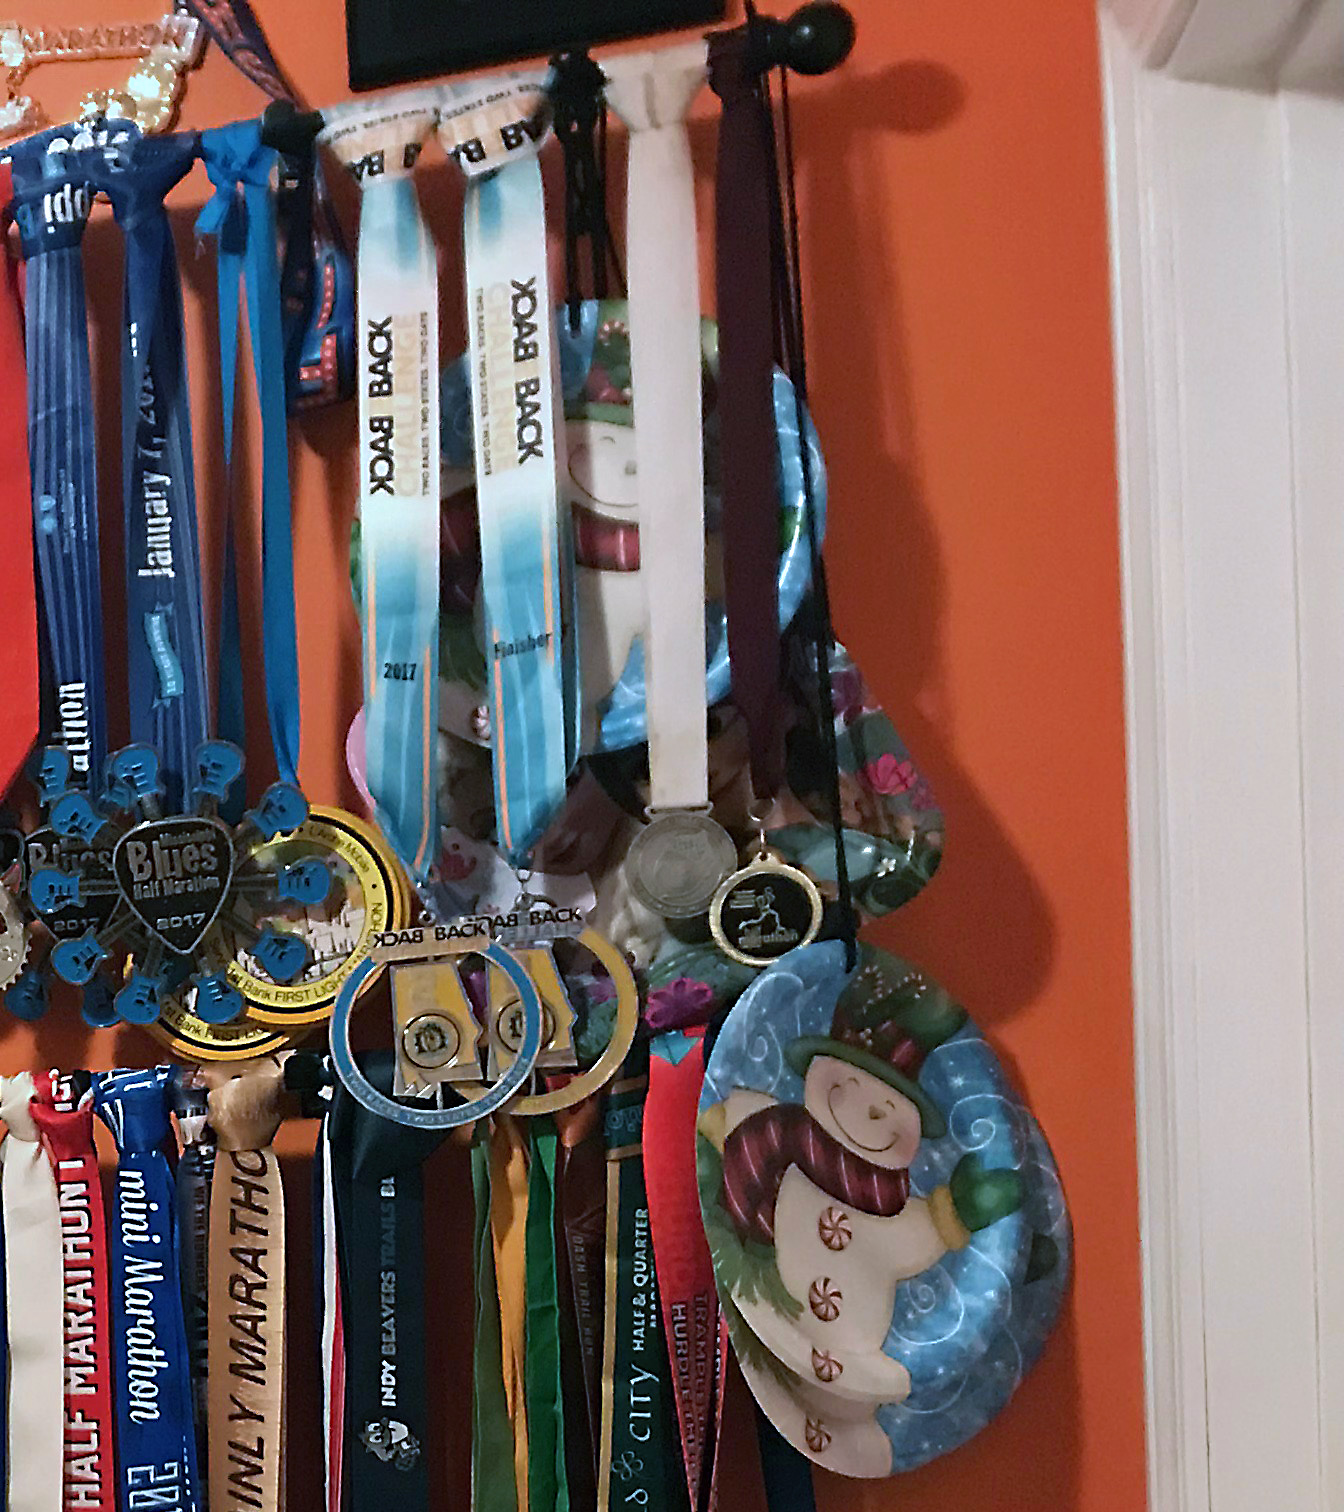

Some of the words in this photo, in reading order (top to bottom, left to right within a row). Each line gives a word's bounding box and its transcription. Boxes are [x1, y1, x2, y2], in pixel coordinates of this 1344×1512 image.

[137, 470, 174, 578] January
[383, 663, 417, 681] 2017
[494, 631, 552, 660] Finisher
[127, 841, 218, 882] Blues
[156, 913, 207, 931] 2017
[434, 923, 484, 941] BACK
[530, 907, 583, 925] BACK
[274, 990, 311, 1004] FIRST
[118, 1170, 152, 1248] mini
[228, 1148, 269, 1381] MARATHO
[632, 1207, 648, 1287] QUARTER
[62, 1180, 99, 1395] MARATHON
[380, 1271, 397, 1356] BEAVERS
[121, 1252, 170, 1425] Marathon
[632, 1308, 646, 1352] HALF
[380, 1360, 397, 1407] INDY
[627, 1362, 660, 1441] CITY
[62, 1412, 103, 1509] HALF
